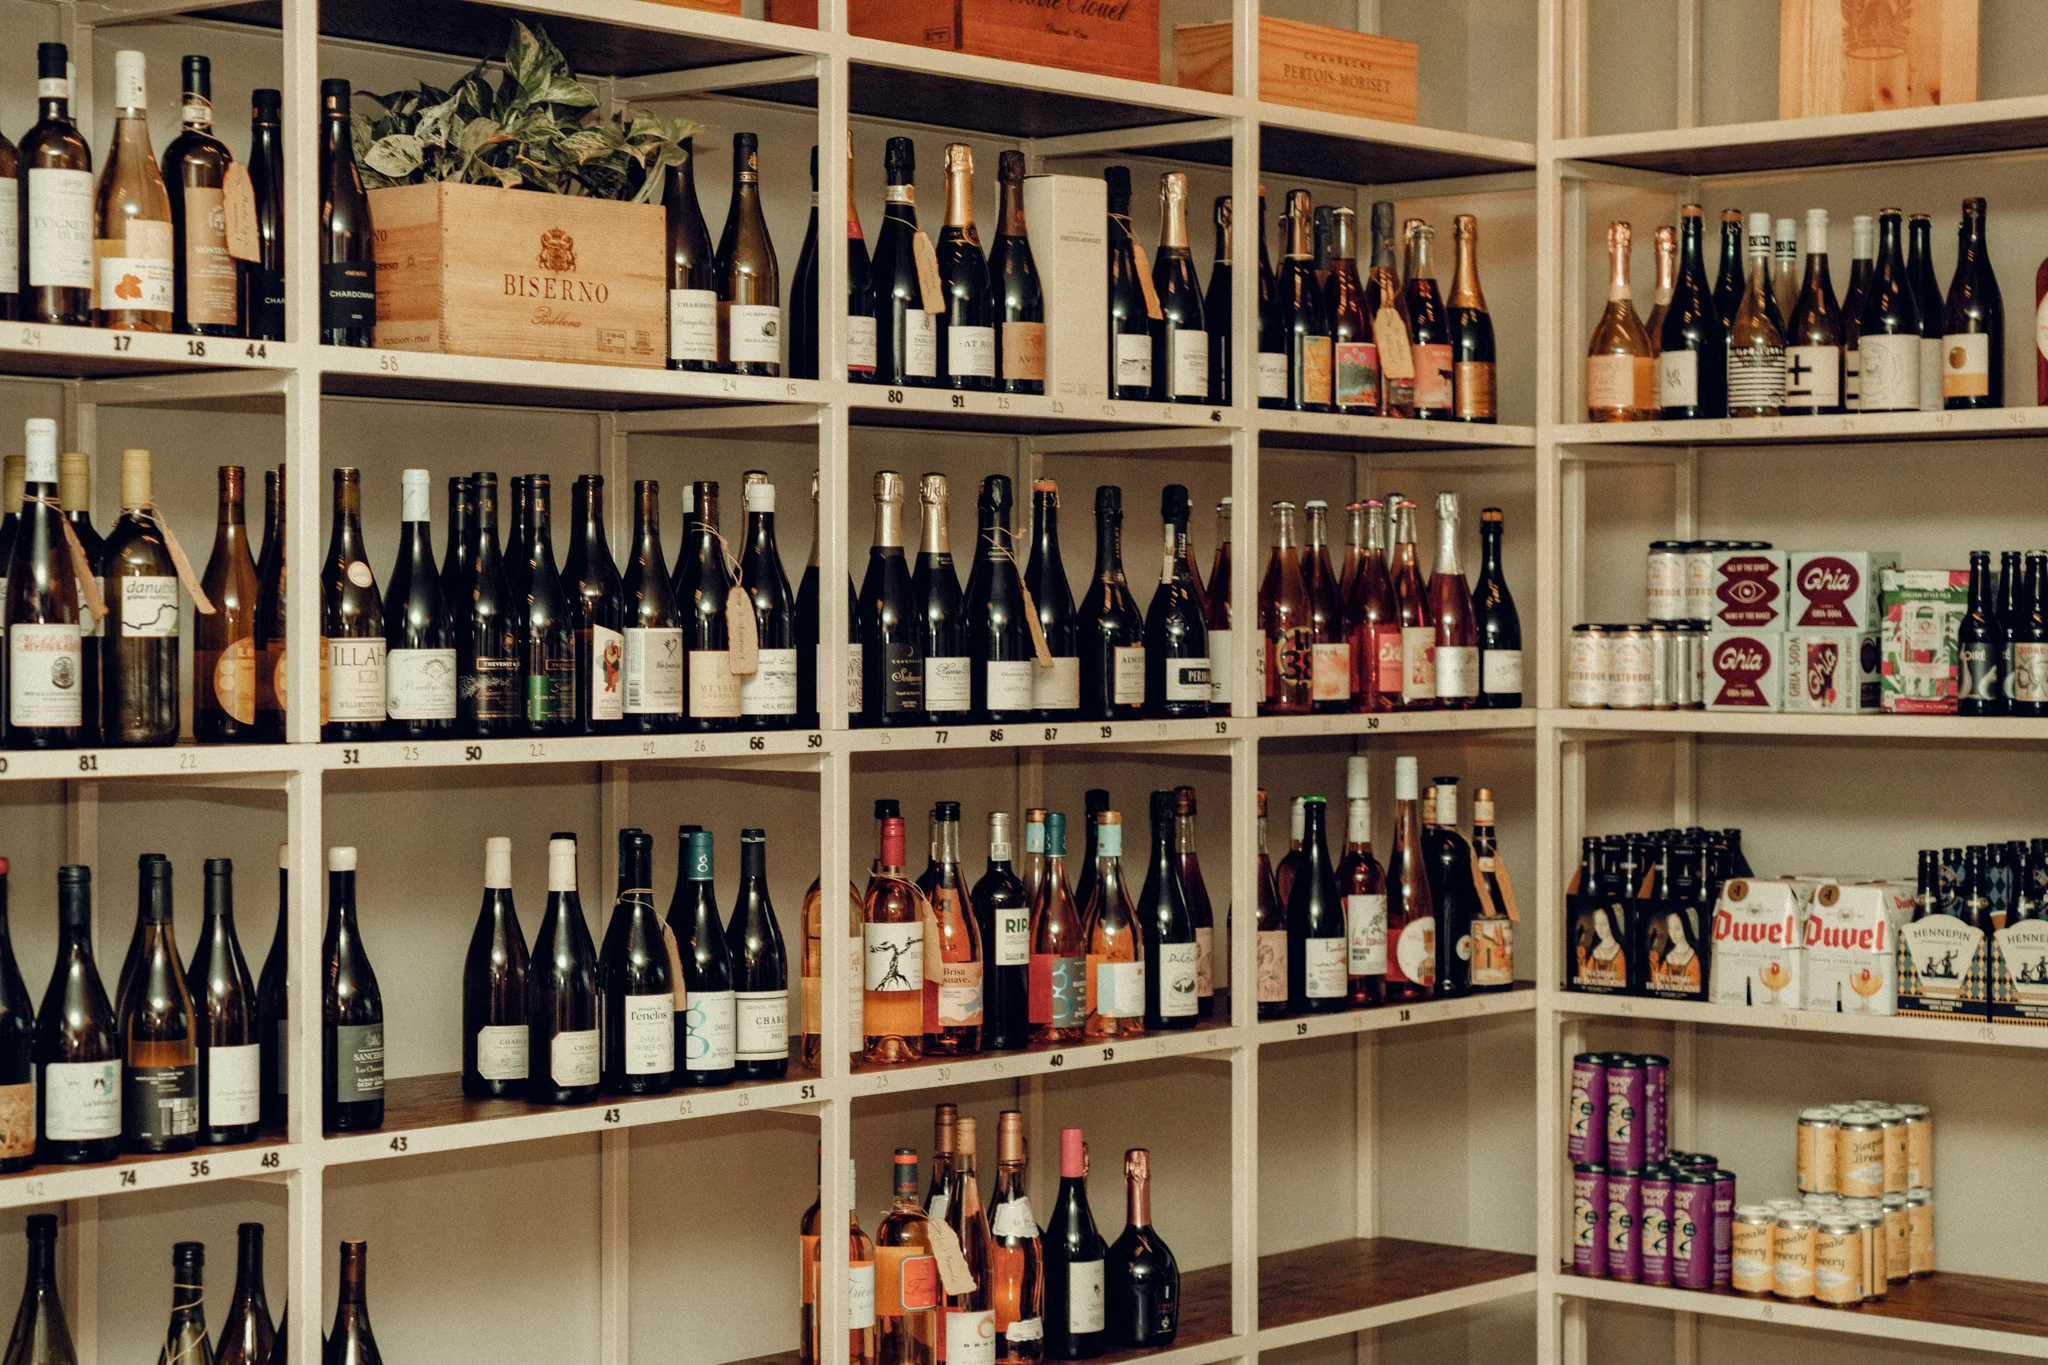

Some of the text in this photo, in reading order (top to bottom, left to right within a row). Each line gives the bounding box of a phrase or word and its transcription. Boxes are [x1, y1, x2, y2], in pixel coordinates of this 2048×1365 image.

[1283, 63, 1391, 93] PERTOIS-MORISET
[504, 273, 609, 303] BISERNO
[113, 336, 131, 351] 17
[187, 341, 206, 357] 18
[246, 344, 267, 359] 44
[380, 355, 398, 371] 58
[722, 379, 737, 392] 24
[888, 390, 903, 404] 80
[952, 395, 966, 408] 91
[1052, 401, 1064, 413] 23
[1804, 567, 1851, 591] Ghia
[1719, 647, 1763, 671] Ghia
[1808, 647, 1837, 694] Ghia
[1216, 721, 1227, 734] 19
[1367, 717, 1379, 729] 30
[935, 730, 949, 744] 77
[990, 729, 1004, 742] 86
[1045, 728, 1058, 741] 87
[1101, 726, 1112, 738] 19
[694, 740, 706, 752] 26
[750, 736, 765, 750] 66
[808, 734, 823, 748] 50
[343, 749, 360, 764] 31
[404, 747, 420, 762] 25
[465, 746, 483, 761] 50
[530, 743, 546, 757] 22
[79, 755, 98, 771] 81
[180, 753, 197, 769] 22
[1005, 918, 1030, 934] RIP
[1715, 909, 1793, 946] Duvel
[1805, 913, 1885, 952] Duvel
[1913, 926, 1971, 942] HENNEPIN
[943, 967, 966, 976] Brisa
[943, 976, 971, 985] suave.
[1400, 1010, 1410, 1022] 18
[1297, 1024, 1307, 1035] 19
[1979, 1026, 1996, 1041] 18
[1050, 1054, 1063, 1067] 40
[1103, 1048, 1114, 1061] 19
[937, 1067, 951, 1081] 30
[876, 1075, 889, 1089] 23
[801, 1085, 816, 1099] 51
[738, 1093, 750, 1107] 28
[680, 1101, 693, 1115] 62
[604, 1109, 621, 1123] 43
[390, 1137, 408, 1151] 43
[261, 1153, 280, 1168] 48
[190, 1161, 210, 1176] 36
[120, 1171, 137, 1187] 74
